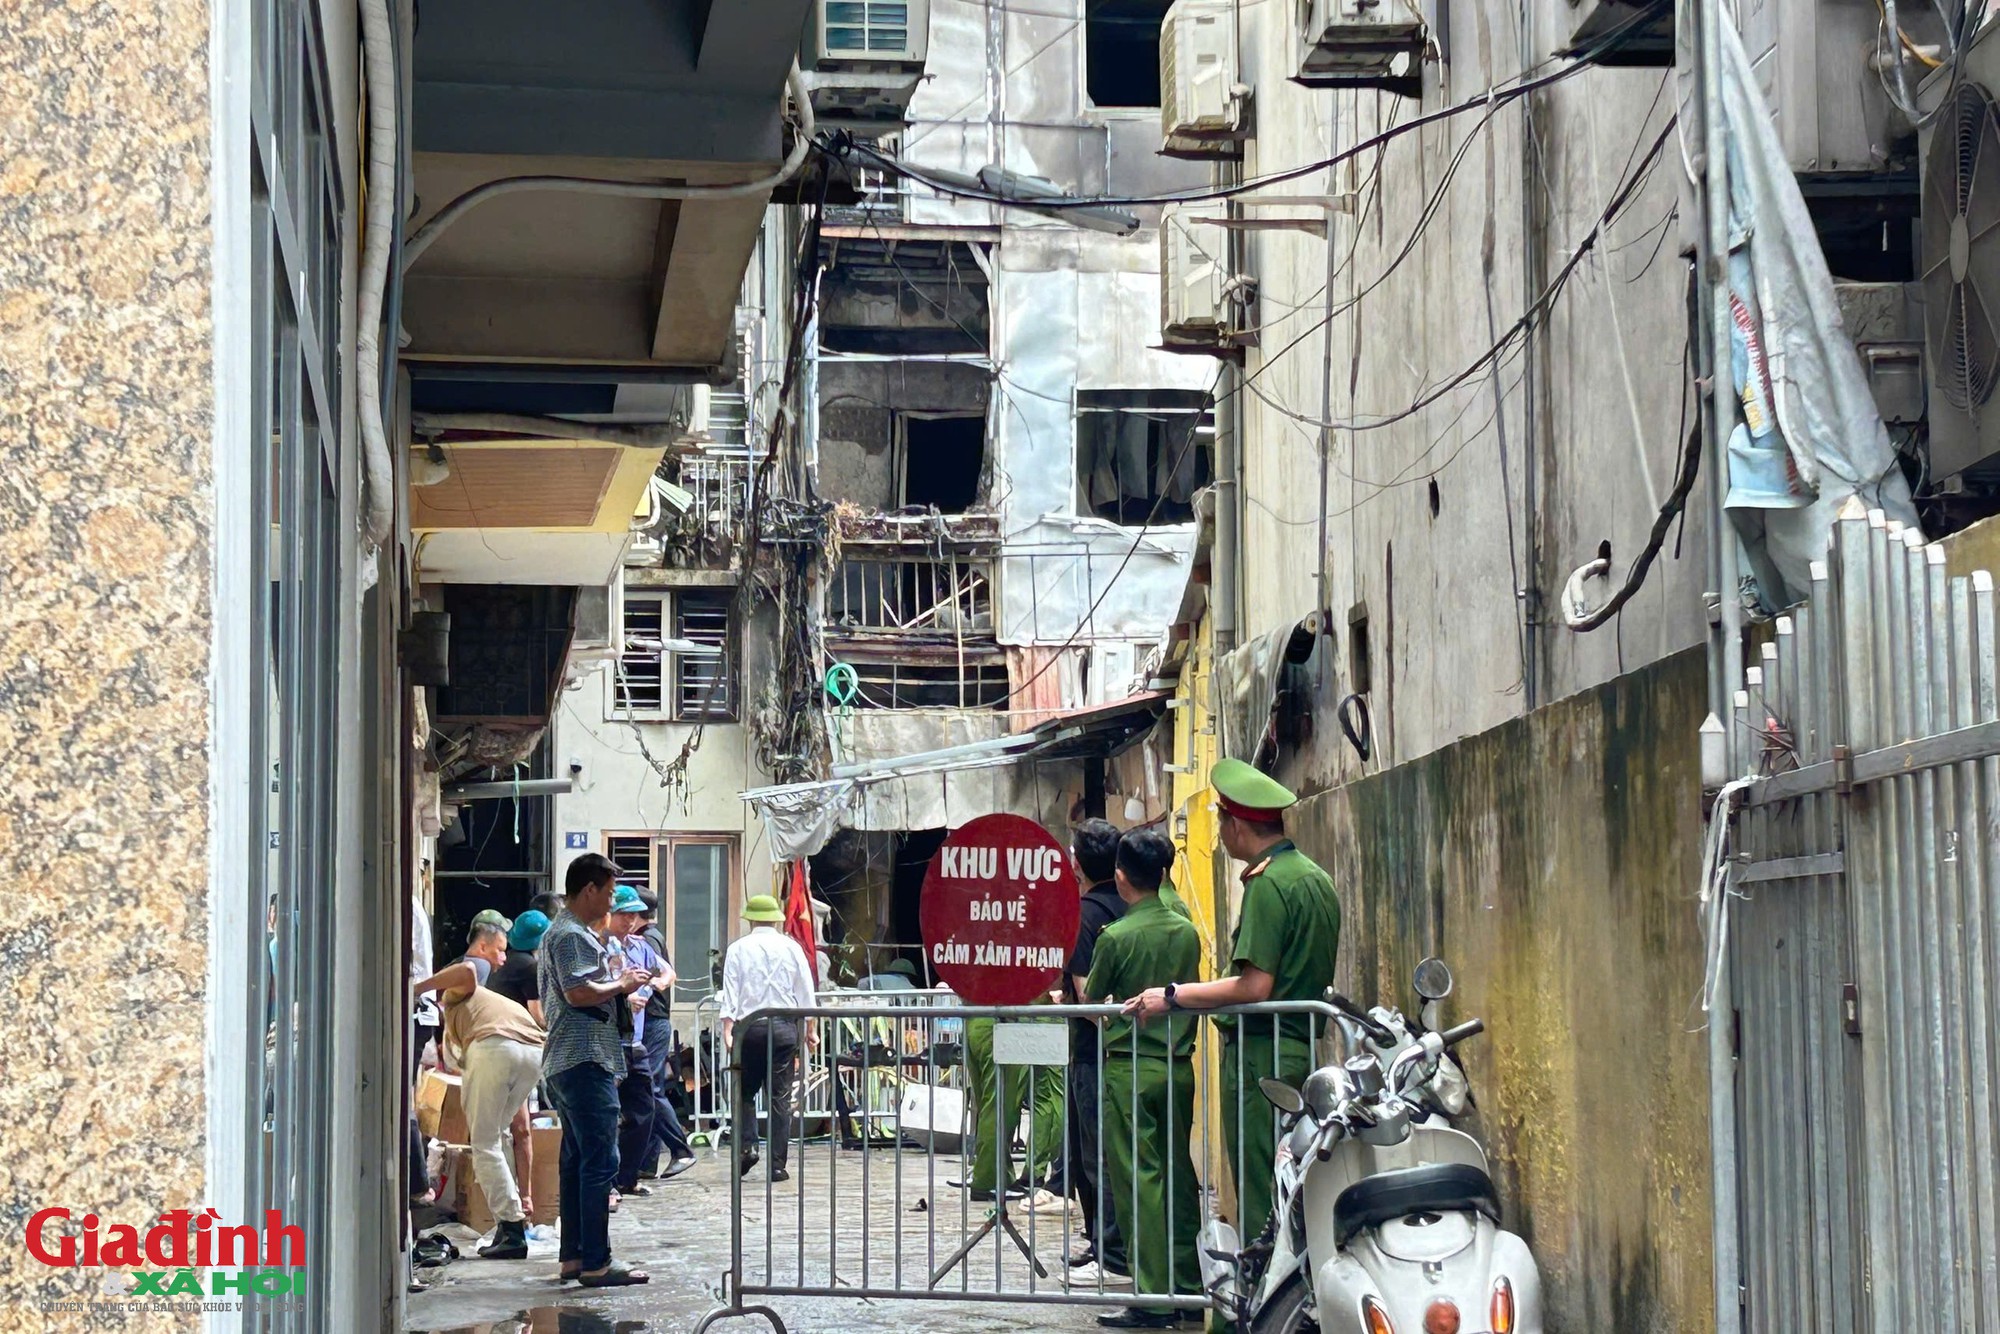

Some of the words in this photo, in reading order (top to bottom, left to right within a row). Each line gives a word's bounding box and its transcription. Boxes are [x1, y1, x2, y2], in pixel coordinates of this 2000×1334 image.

[941, 846, 997, 879] KHU
[1006, 845, 1062, 889] VỰC
[970, 892, 1002, 921] BẢO
[1007, 895, 1027, 928] VỆ
[933, 934, 969, 965] CẤM
[974, 940, 1011, 967] XÂM
[1015, 947, 1064, 973] PHẠM
